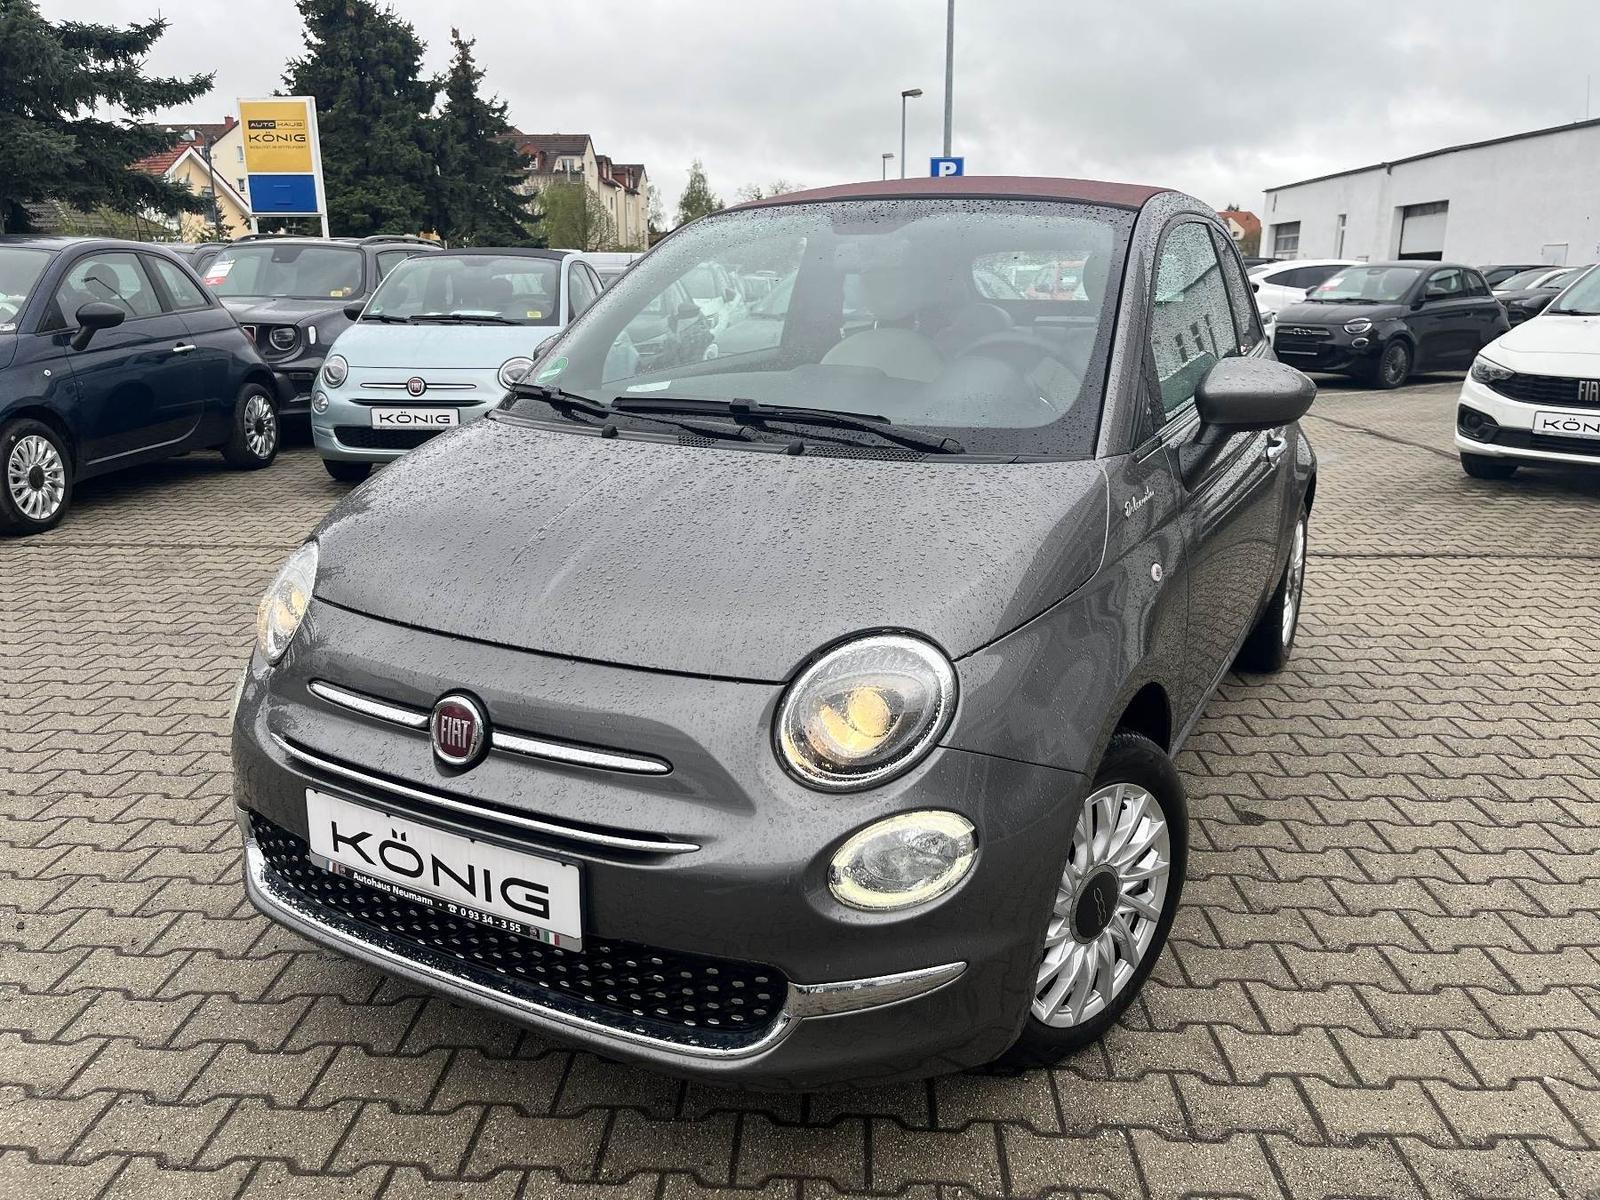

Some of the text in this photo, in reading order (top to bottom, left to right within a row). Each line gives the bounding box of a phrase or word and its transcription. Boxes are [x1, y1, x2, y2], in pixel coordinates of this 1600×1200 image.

[249, 131, 306, 143] KÖNIG
[938, 161, 957, 177] P
[1578, 380, 1600, 402] FIA
[379, 410, 451, 424] KÖNIG
[440, 715, 471, 749] FIAT
[330, 820, 550, 920] KÖNIG
[353, 871, 391, 893] Autohaus
[393, 885, 433, 906] Neumann
[460, 908, 467, 917] 0
[468, 910, 480, 921] 93
[481, 914, 493, 925] 34
[509, 922, 521, 933] 55
